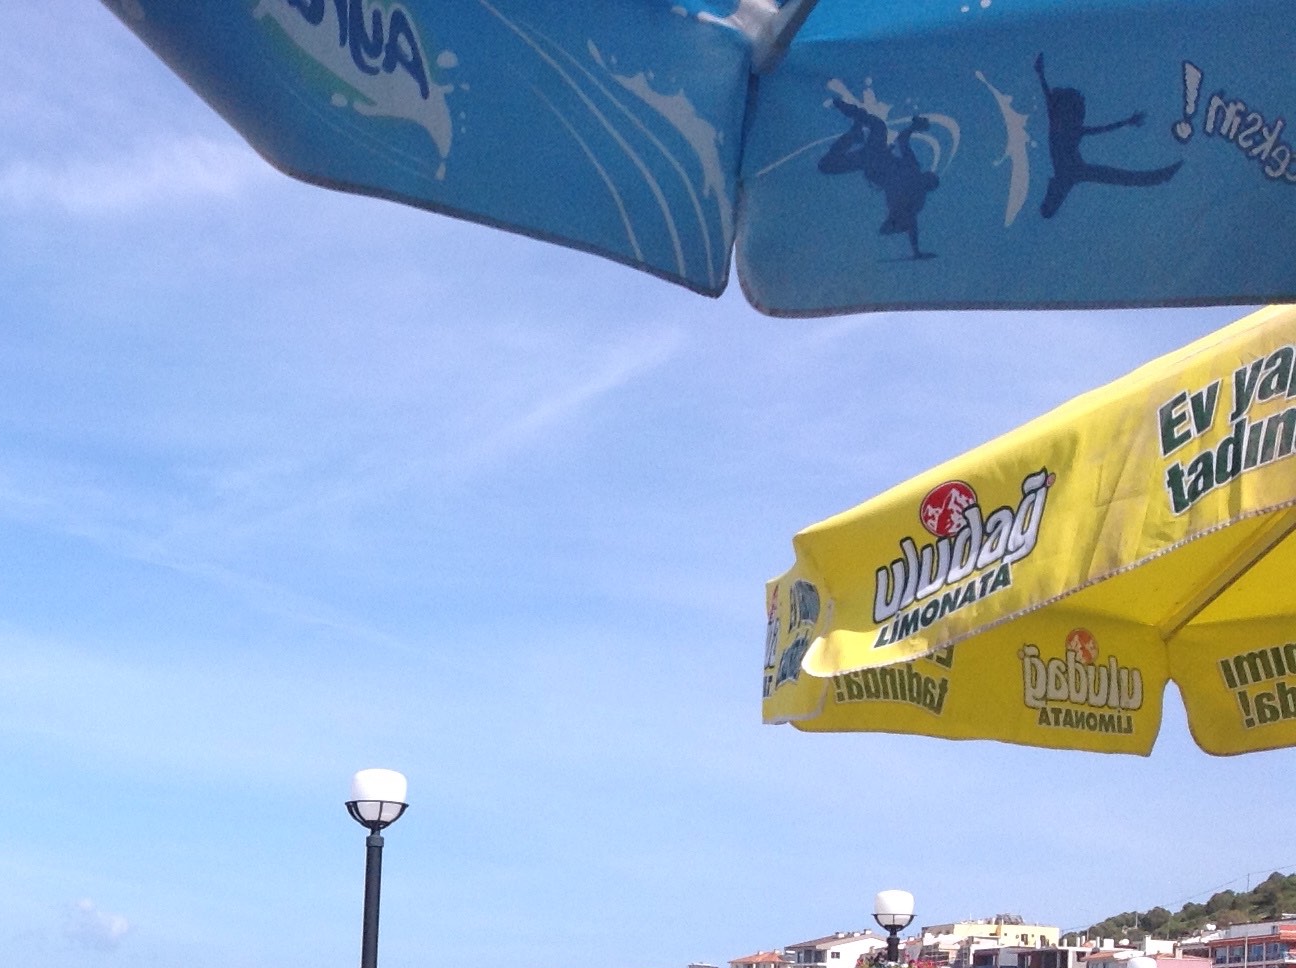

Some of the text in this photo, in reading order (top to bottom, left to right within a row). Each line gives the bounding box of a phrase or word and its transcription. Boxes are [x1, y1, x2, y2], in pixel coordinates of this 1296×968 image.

[1159, 345, 1296, 456] Ev ya
[1166, 408, 1296, 514] tadın
